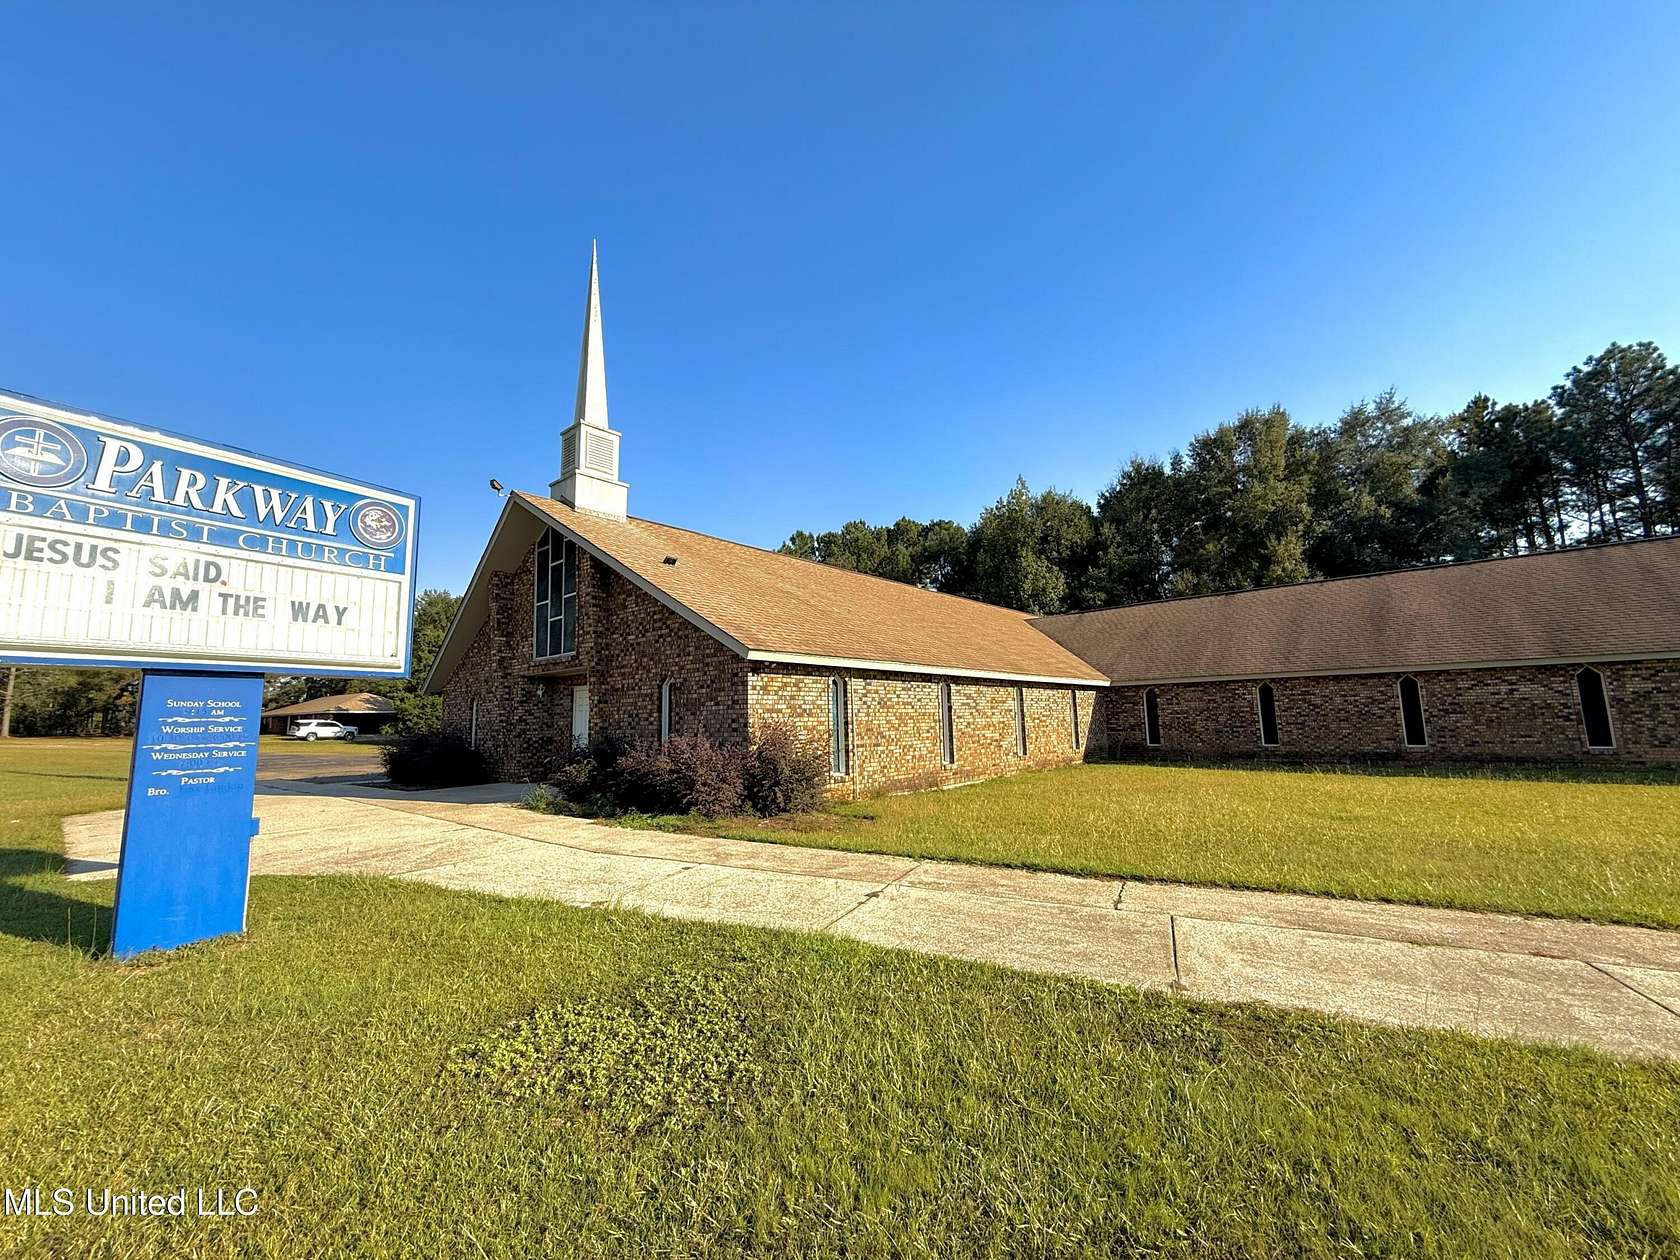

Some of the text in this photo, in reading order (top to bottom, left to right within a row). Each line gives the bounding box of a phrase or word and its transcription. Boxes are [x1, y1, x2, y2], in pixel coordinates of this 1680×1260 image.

[86, 435, 348, 537] PARKWAY
[7, 491, 388, 572] BAPTIST CHURCH
[3, 532, 120, 572] JESUS
[104, 580, 348, 626] I AM THE WAY
[167, 699, 242, 708] SUNDAY SCHOOL
[162, 725, 243, 734] WORSHIP SERVICE
[152, 750, 247, 761] WEDNESDAY SERVICE
[181, 777, 215, 785] PASTOR
[147, 787, 170, 796] Bro.
